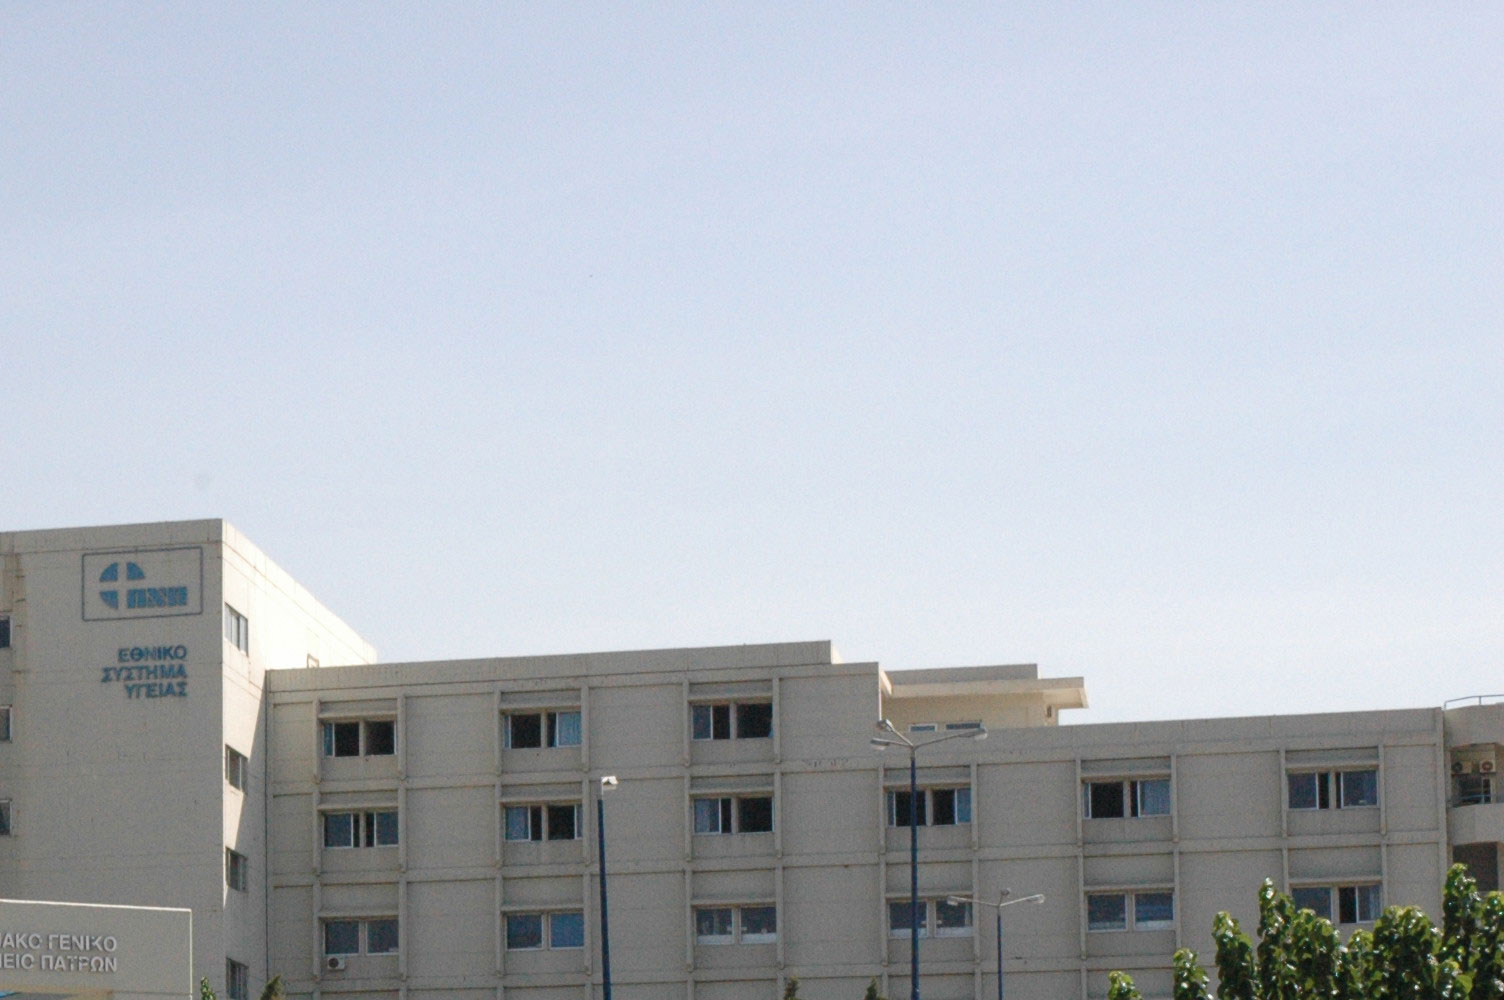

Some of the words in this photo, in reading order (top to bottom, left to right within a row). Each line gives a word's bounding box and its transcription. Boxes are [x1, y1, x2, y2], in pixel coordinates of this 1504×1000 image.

[118, 645, 188, 662] ΕΘΝΙΚΟ
[101, 664, 188, 683] ΣΥΣΤΗΜΑ
[124, 681, 188, 699] ΥΓΕΙΑΣ
[48, 933, 118, 953] ΓΕΝΙΚΟ
[40, 953, 119, 973] ΠΑΤΡΩΝ
